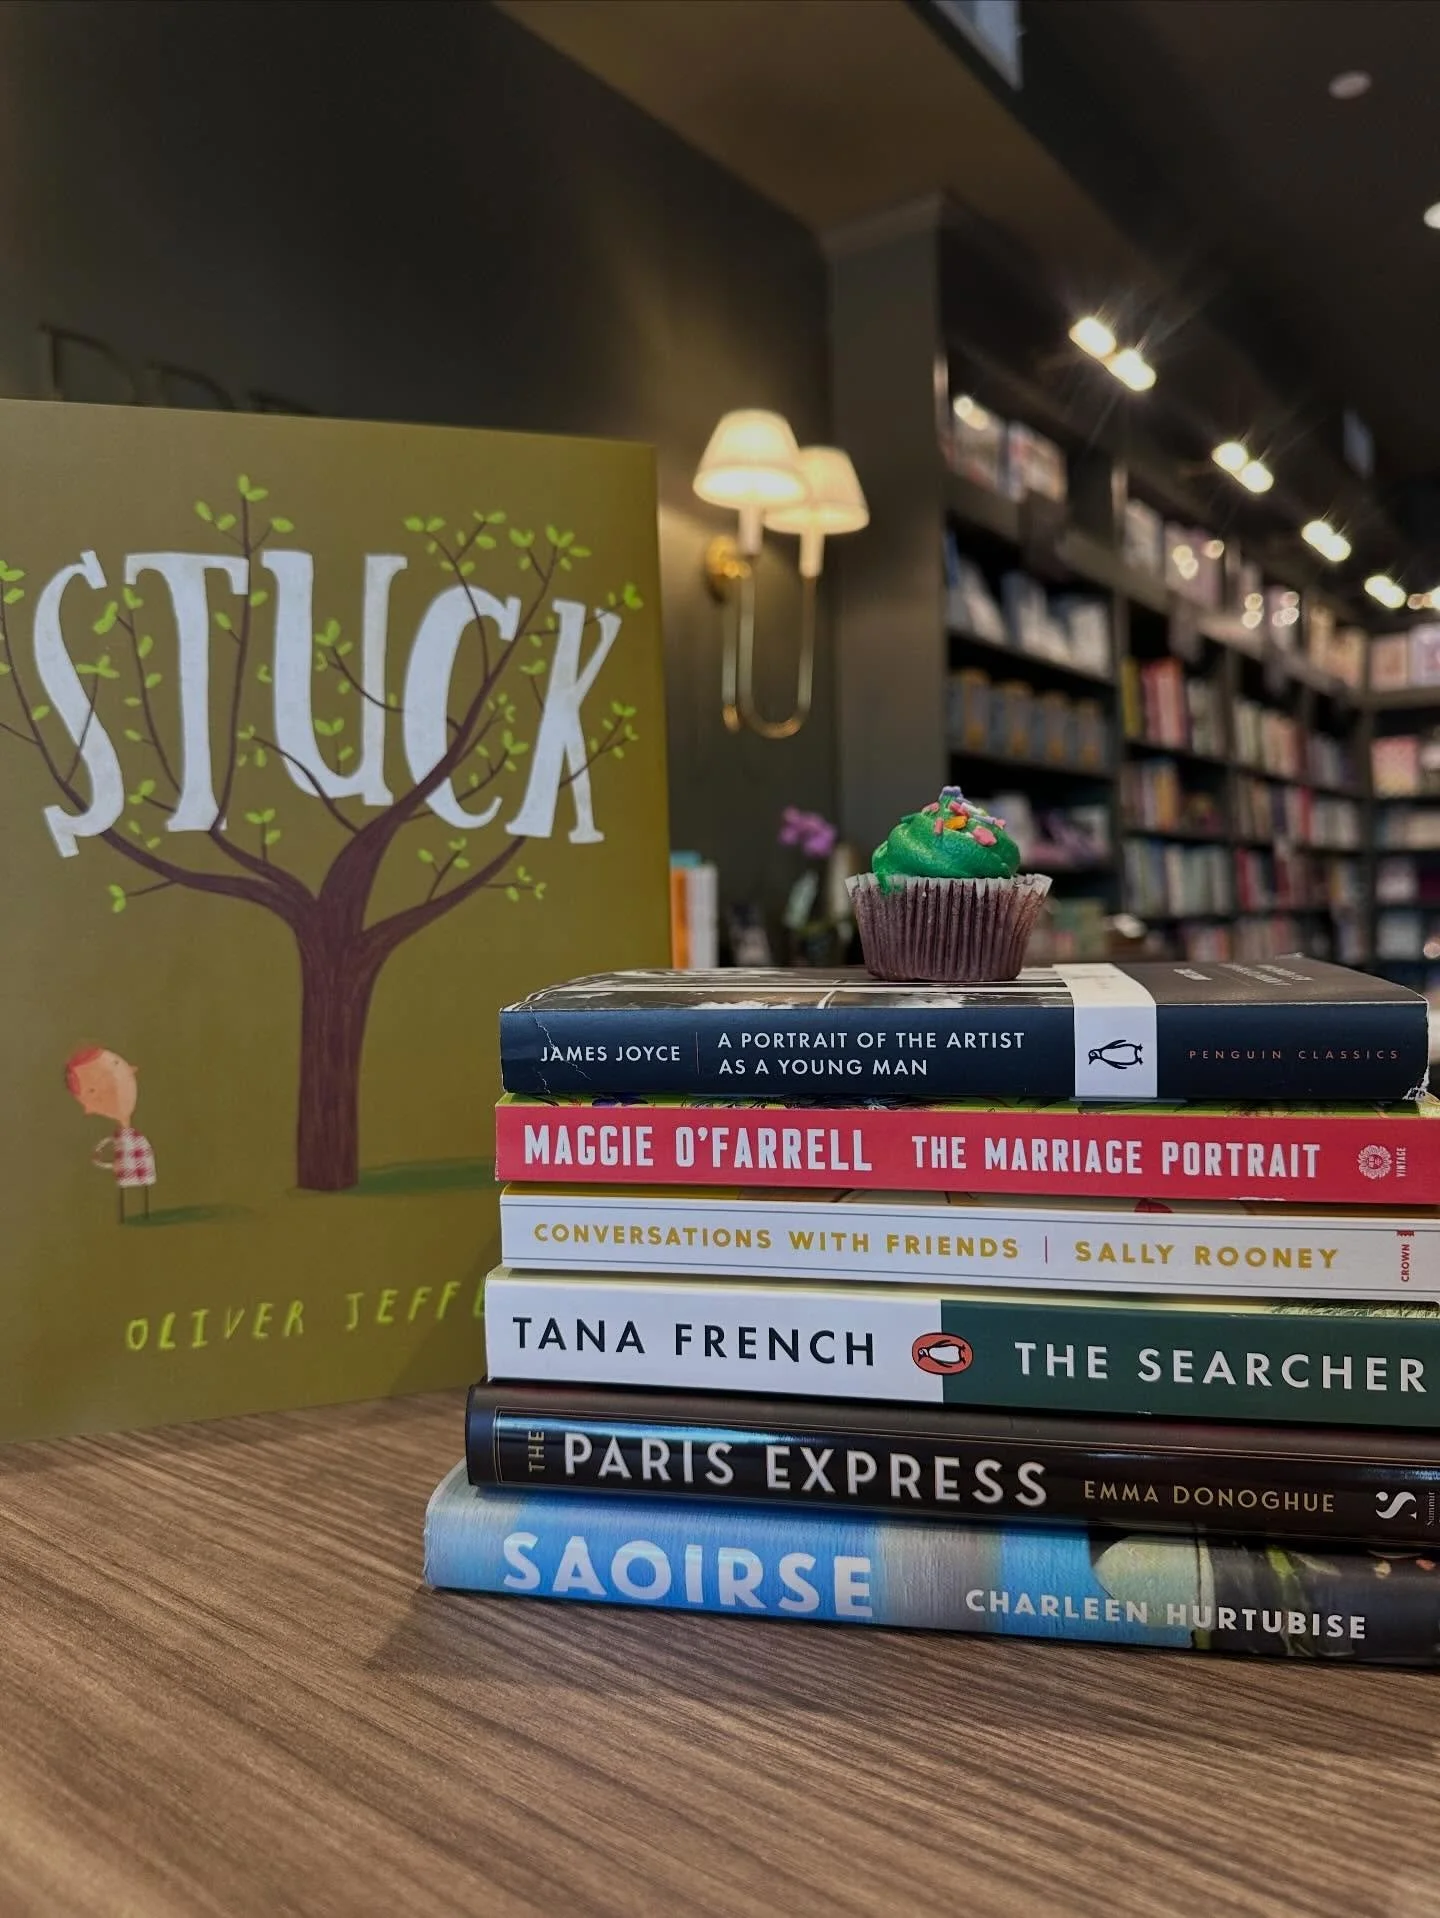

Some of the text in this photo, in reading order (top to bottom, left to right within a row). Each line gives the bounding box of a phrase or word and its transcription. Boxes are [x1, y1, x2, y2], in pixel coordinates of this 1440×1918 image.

[33, 549, 622, 857] STUCK
[541, 1046, 680, 1062] JAMES JOYCE
[718, 1032, 1025, 1049] A PORTRAIT OF THE ARTIST
[1189, 1050, 1399, 1060] PENGUIN CLASSICS
[719, 1059, 927, 1075] AS A YOUNG MAN
[524, 1124, 654, 1166] MAGGIE
[911, 1135, 1320, 1178] THE MARRIAGE PORTRAIT
[1396, 1147, 1406, 1177] VINTAGE
[534, 1224, 1020, 1258] CONVERSATIONS WITH FRIENDS
[1075, 1241, 1338, 1269] SALLY ROONEY
[1401, 1244, 1410, 1282] CROWN
[125, 1300, 305, 1350] OLIVER
[513, 1316, 874, 1366] TANA FRENCH
[1015, 1342, 1427, 1393] THE SEARCHER
[528, 1430, 543, 1473] THE
[564, 1433, 1048, 1508] PARIS EXPRESS
[1085, 1480, 1335, 1513] EMMA DONOGHUE
[503, 1531, 872, 1617] SAOIRSE
[966, 1590, 1366, 1640] CHARLEEN HURTUBISE
